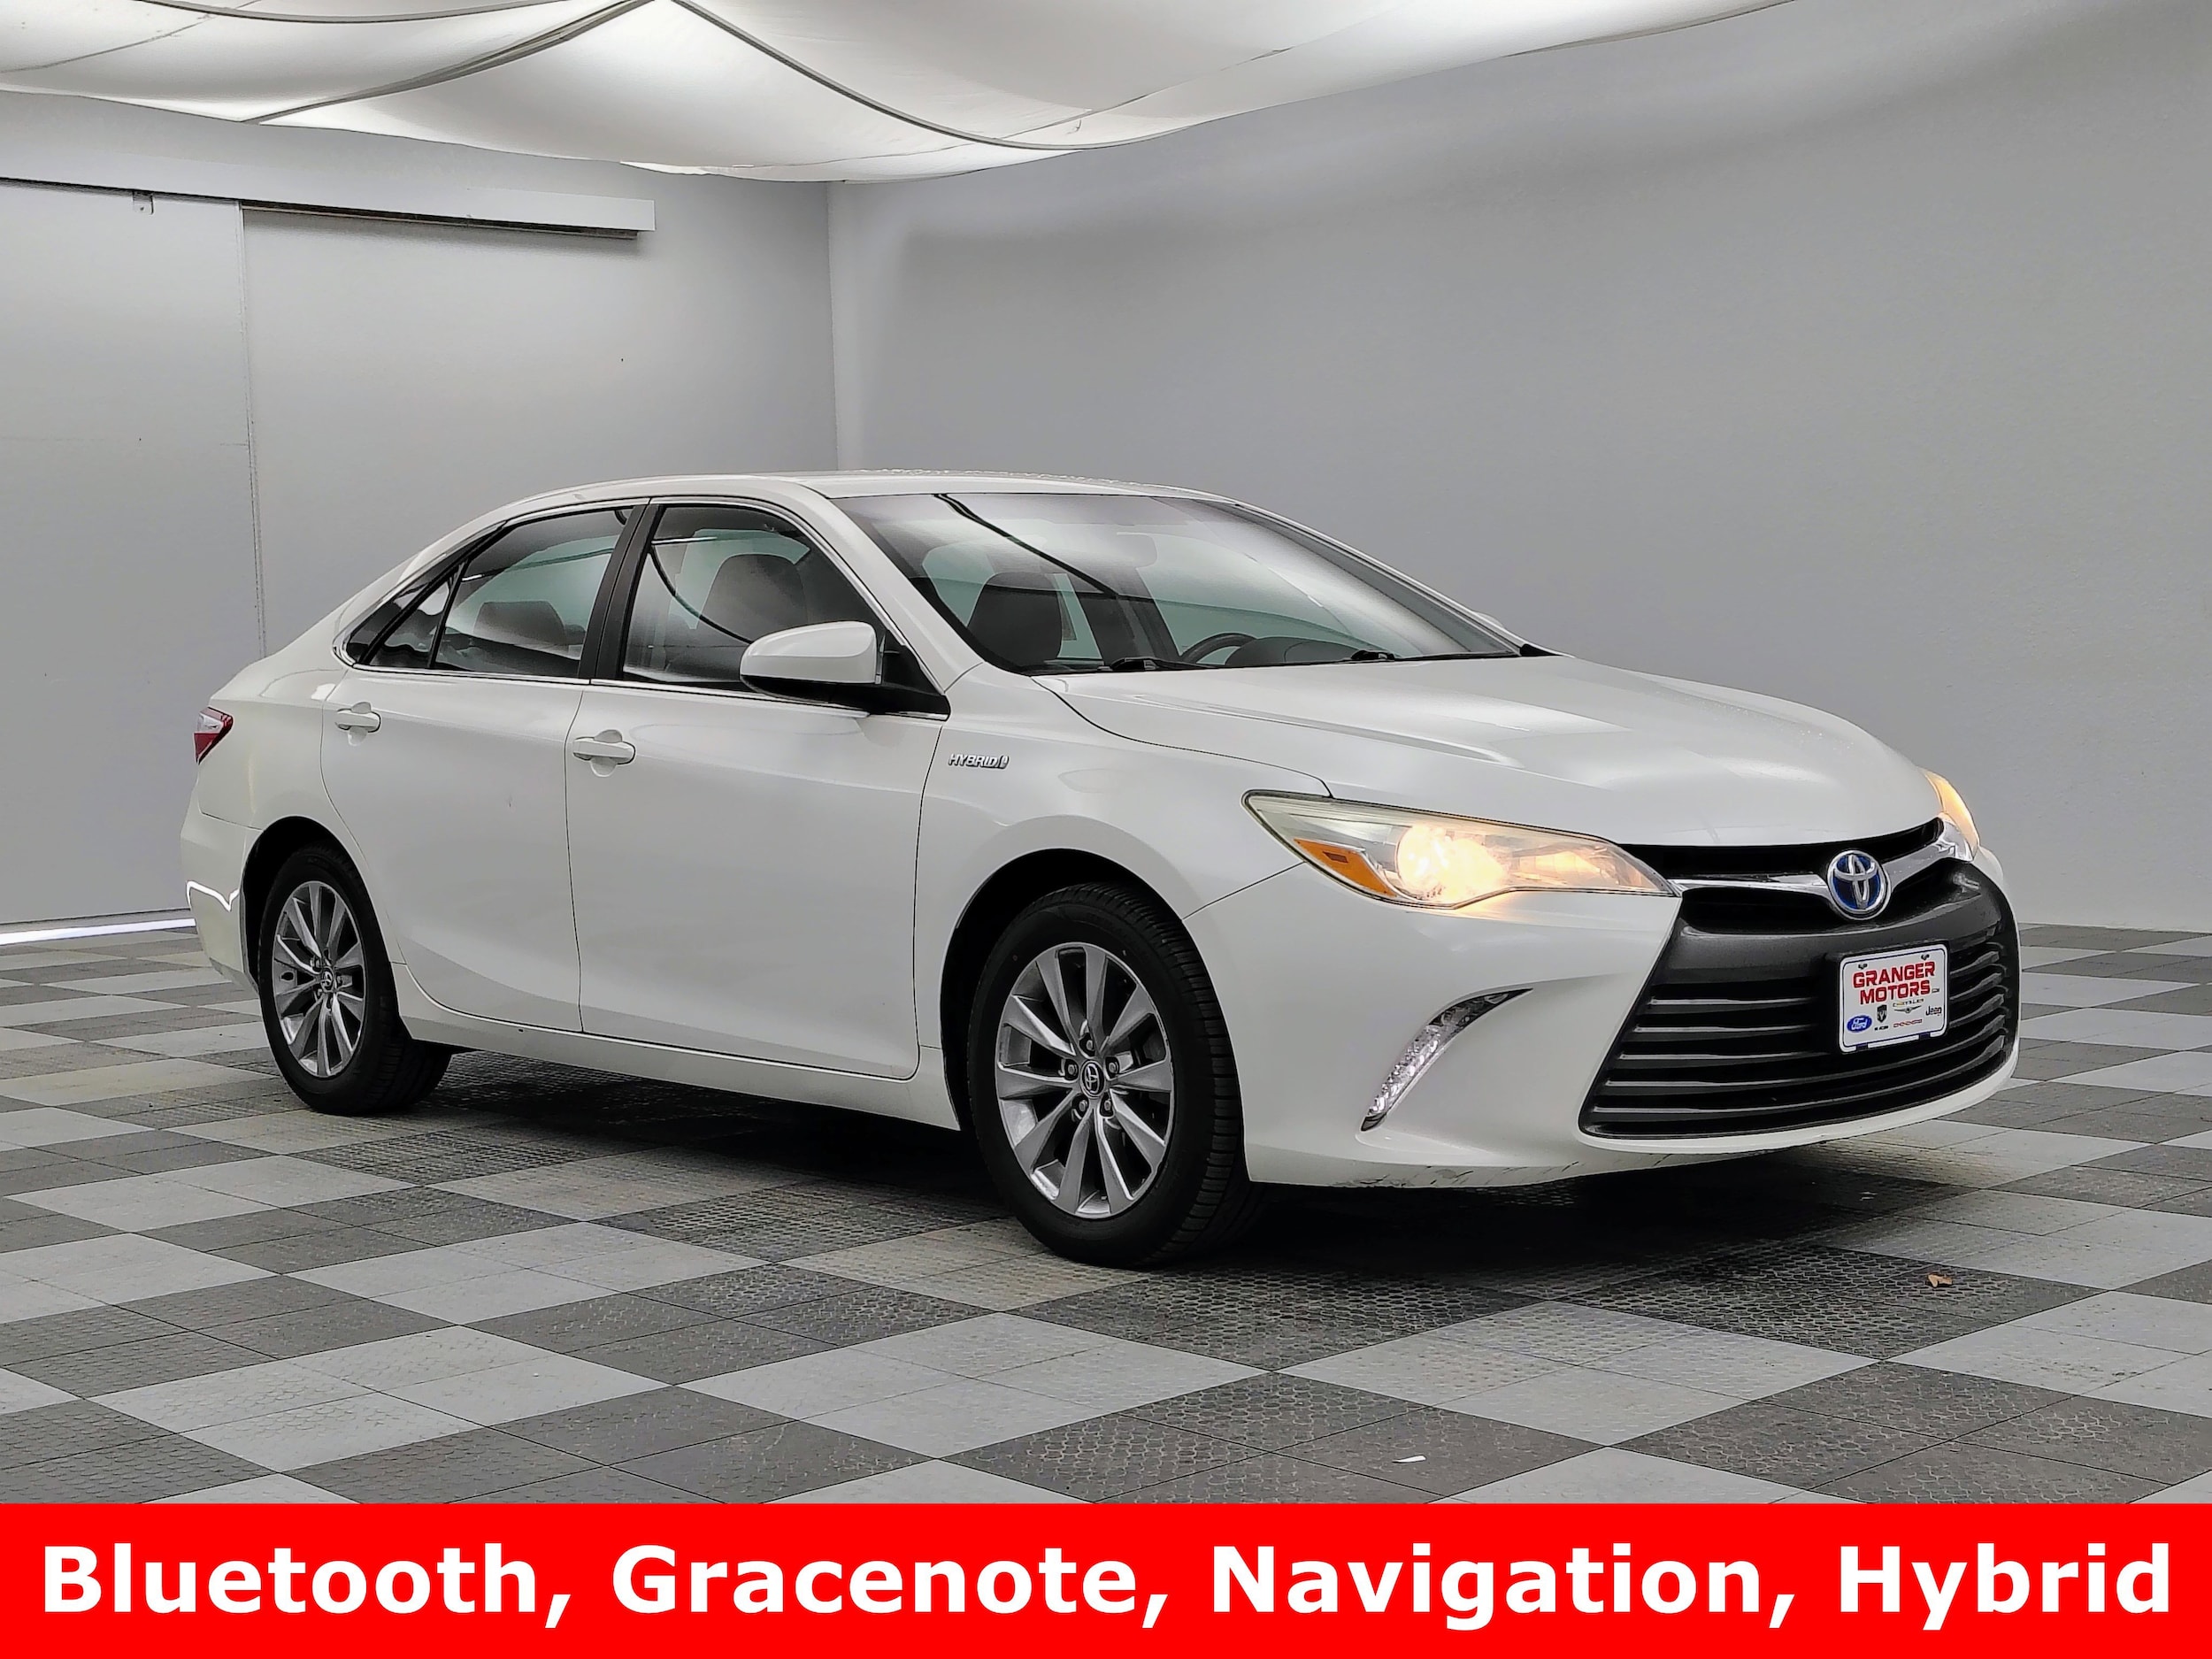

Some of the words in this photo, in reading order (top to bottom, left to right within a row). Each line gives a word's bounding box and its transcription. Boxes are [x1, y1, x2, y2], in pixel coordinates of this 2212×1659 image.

[949, 753, 999, 768] HYBRID
[1853, 961, 1936, 988] GRANGER
[1860, 979, 1931, 1005] MOTORS
[1851, 1018, 1869, 1031] Ford
